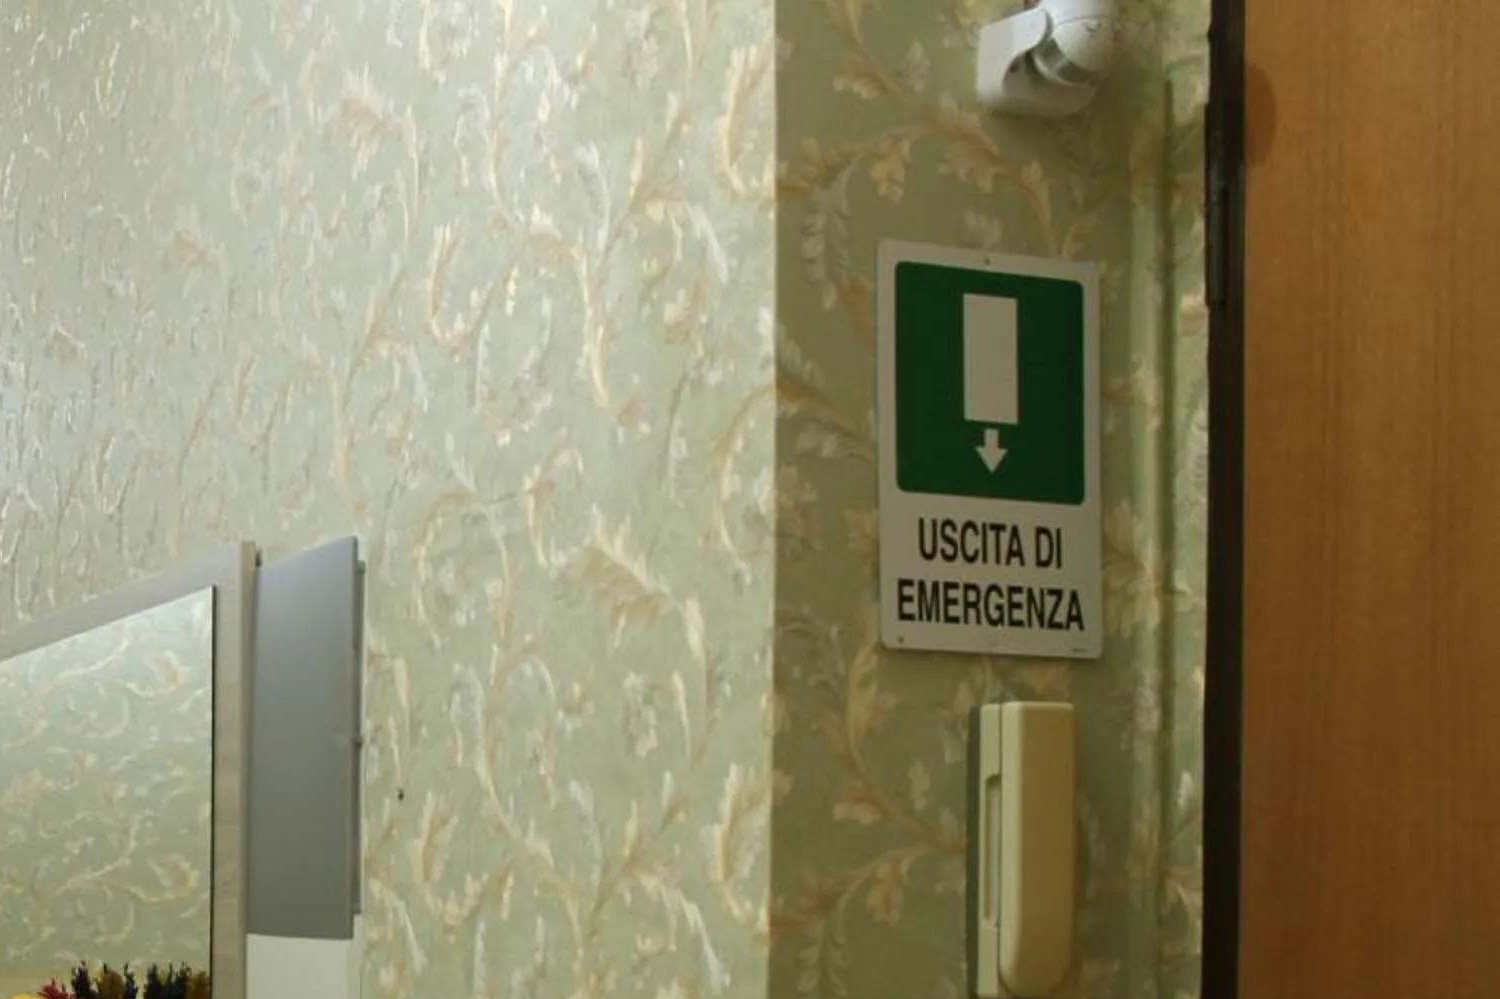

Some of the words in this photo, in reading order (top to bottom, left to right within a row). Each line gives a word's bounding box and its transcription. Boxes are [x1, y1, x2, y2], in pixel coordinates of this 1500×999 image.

[918, 517, 1026, 567] USCITA
[1034, 525, 1063, 570] DI
[897, 578, 1085, 632] EMERGENZA
